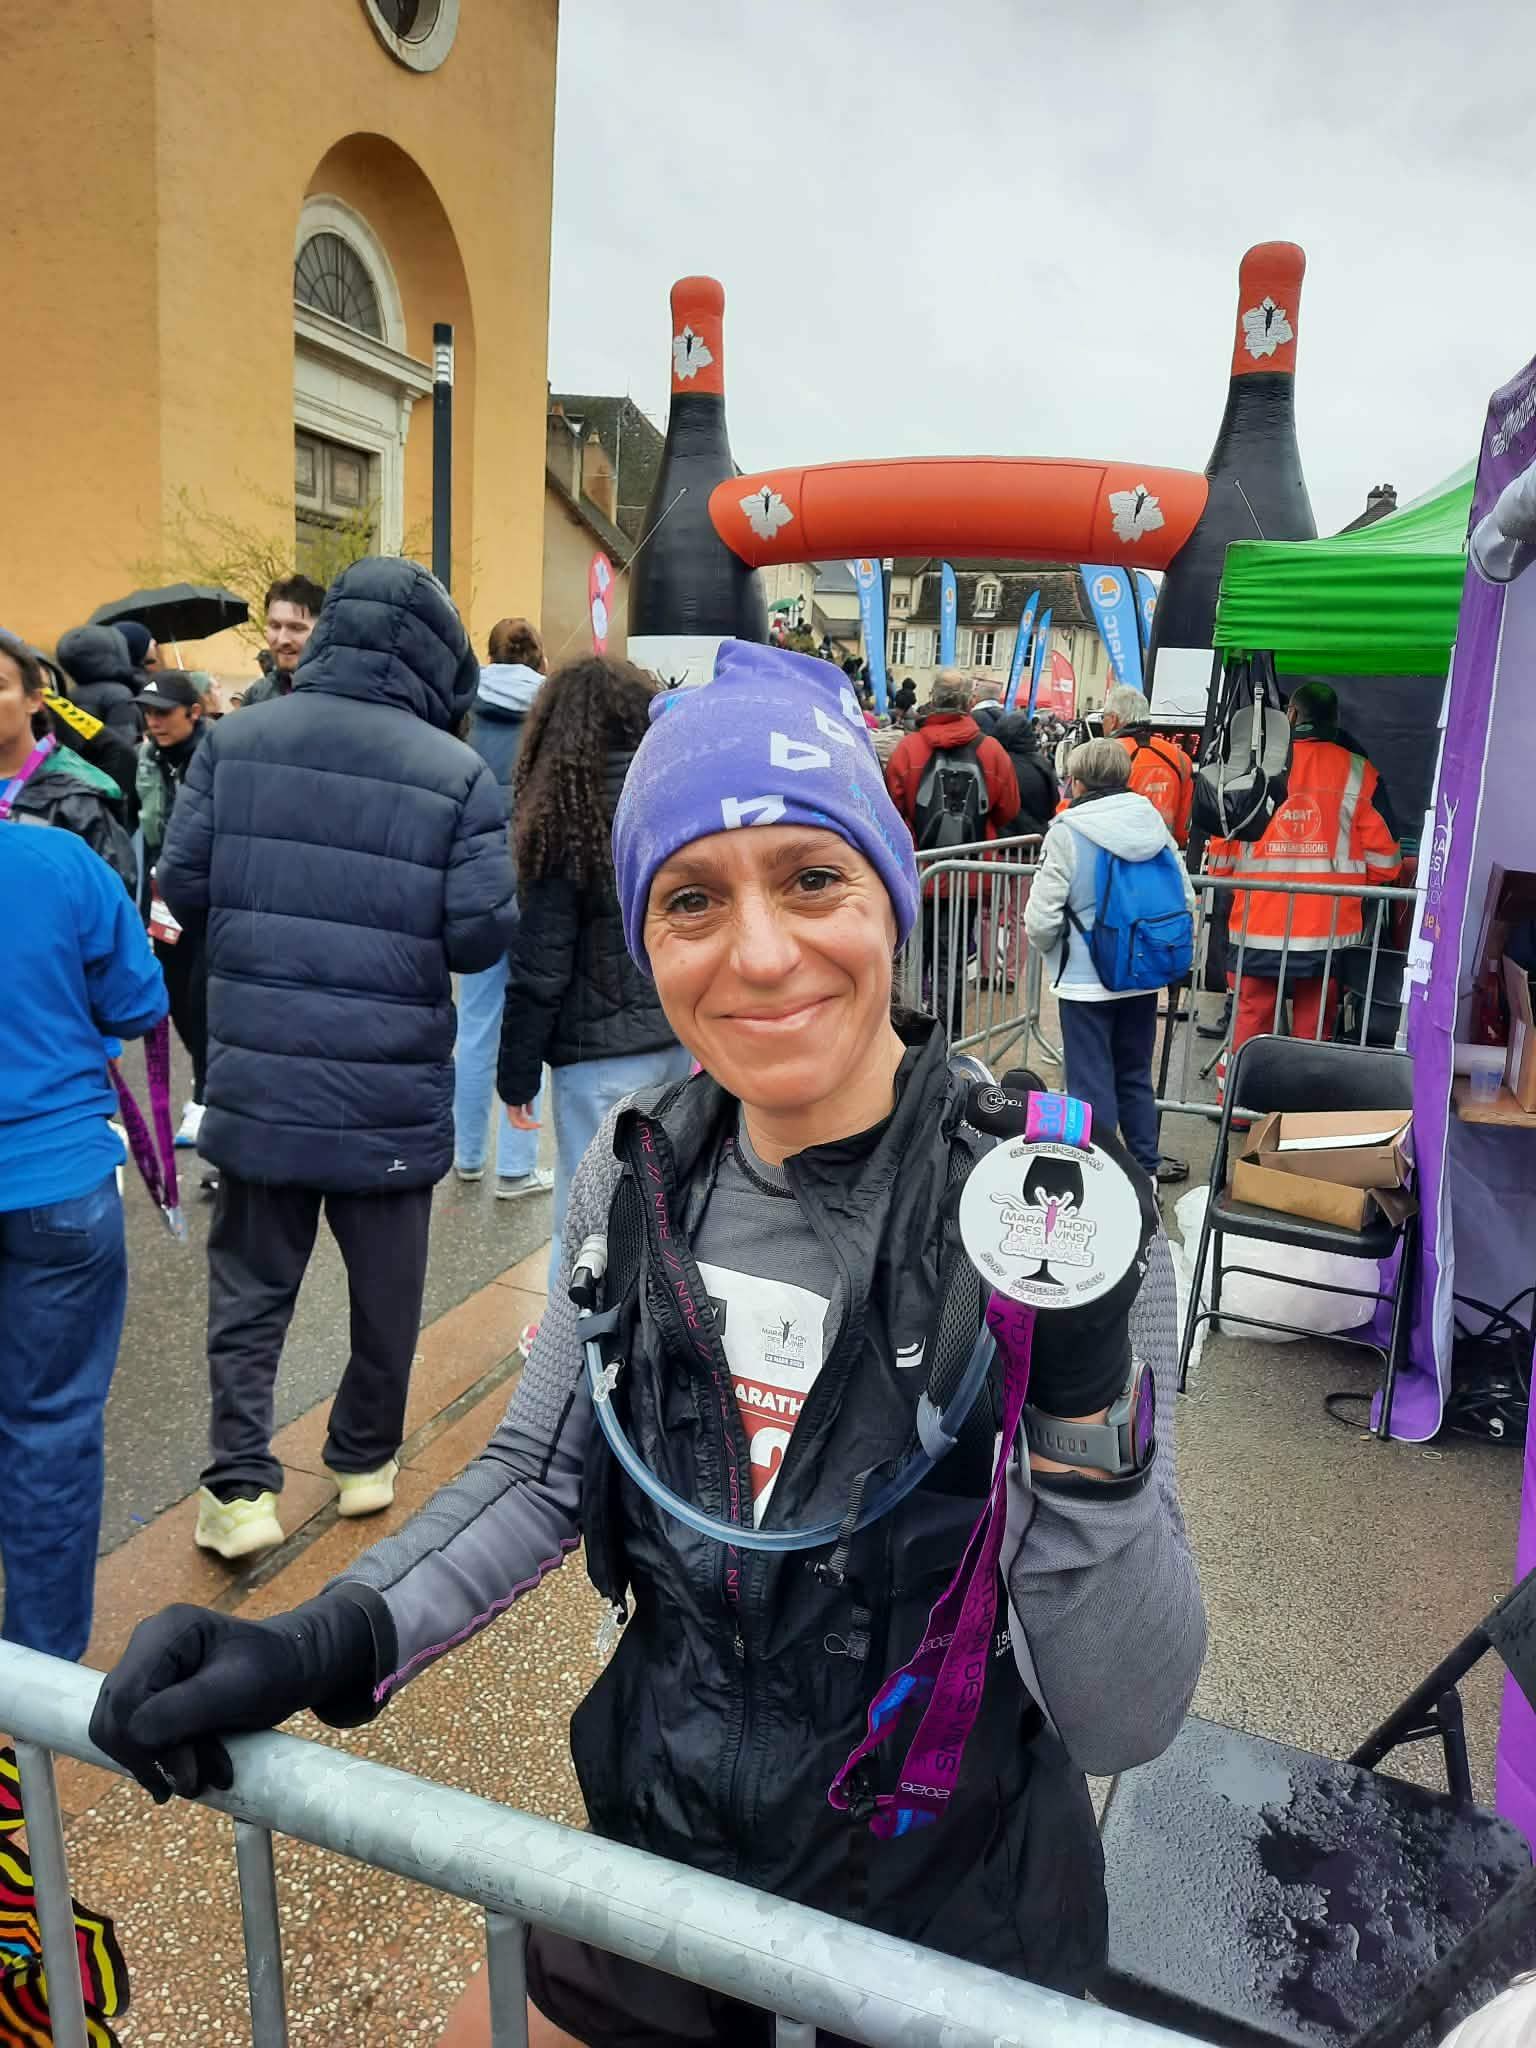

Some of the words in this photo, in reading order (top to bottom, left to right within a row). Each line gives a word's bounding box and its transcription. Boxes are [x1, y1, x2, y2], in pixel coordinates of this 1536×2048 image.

[655, 1193, 671, 1240] RUN
[1054, 1231, 1085, 1243] VINS
[678, 1280, 700, 1329] RUN
[734, 1384, 806, 1416] ARATH
[729, 1466, 739, 1521] RUN
[726, 1568, 740, 1603] UN
[900, 1780, 951, 1799] 2026
